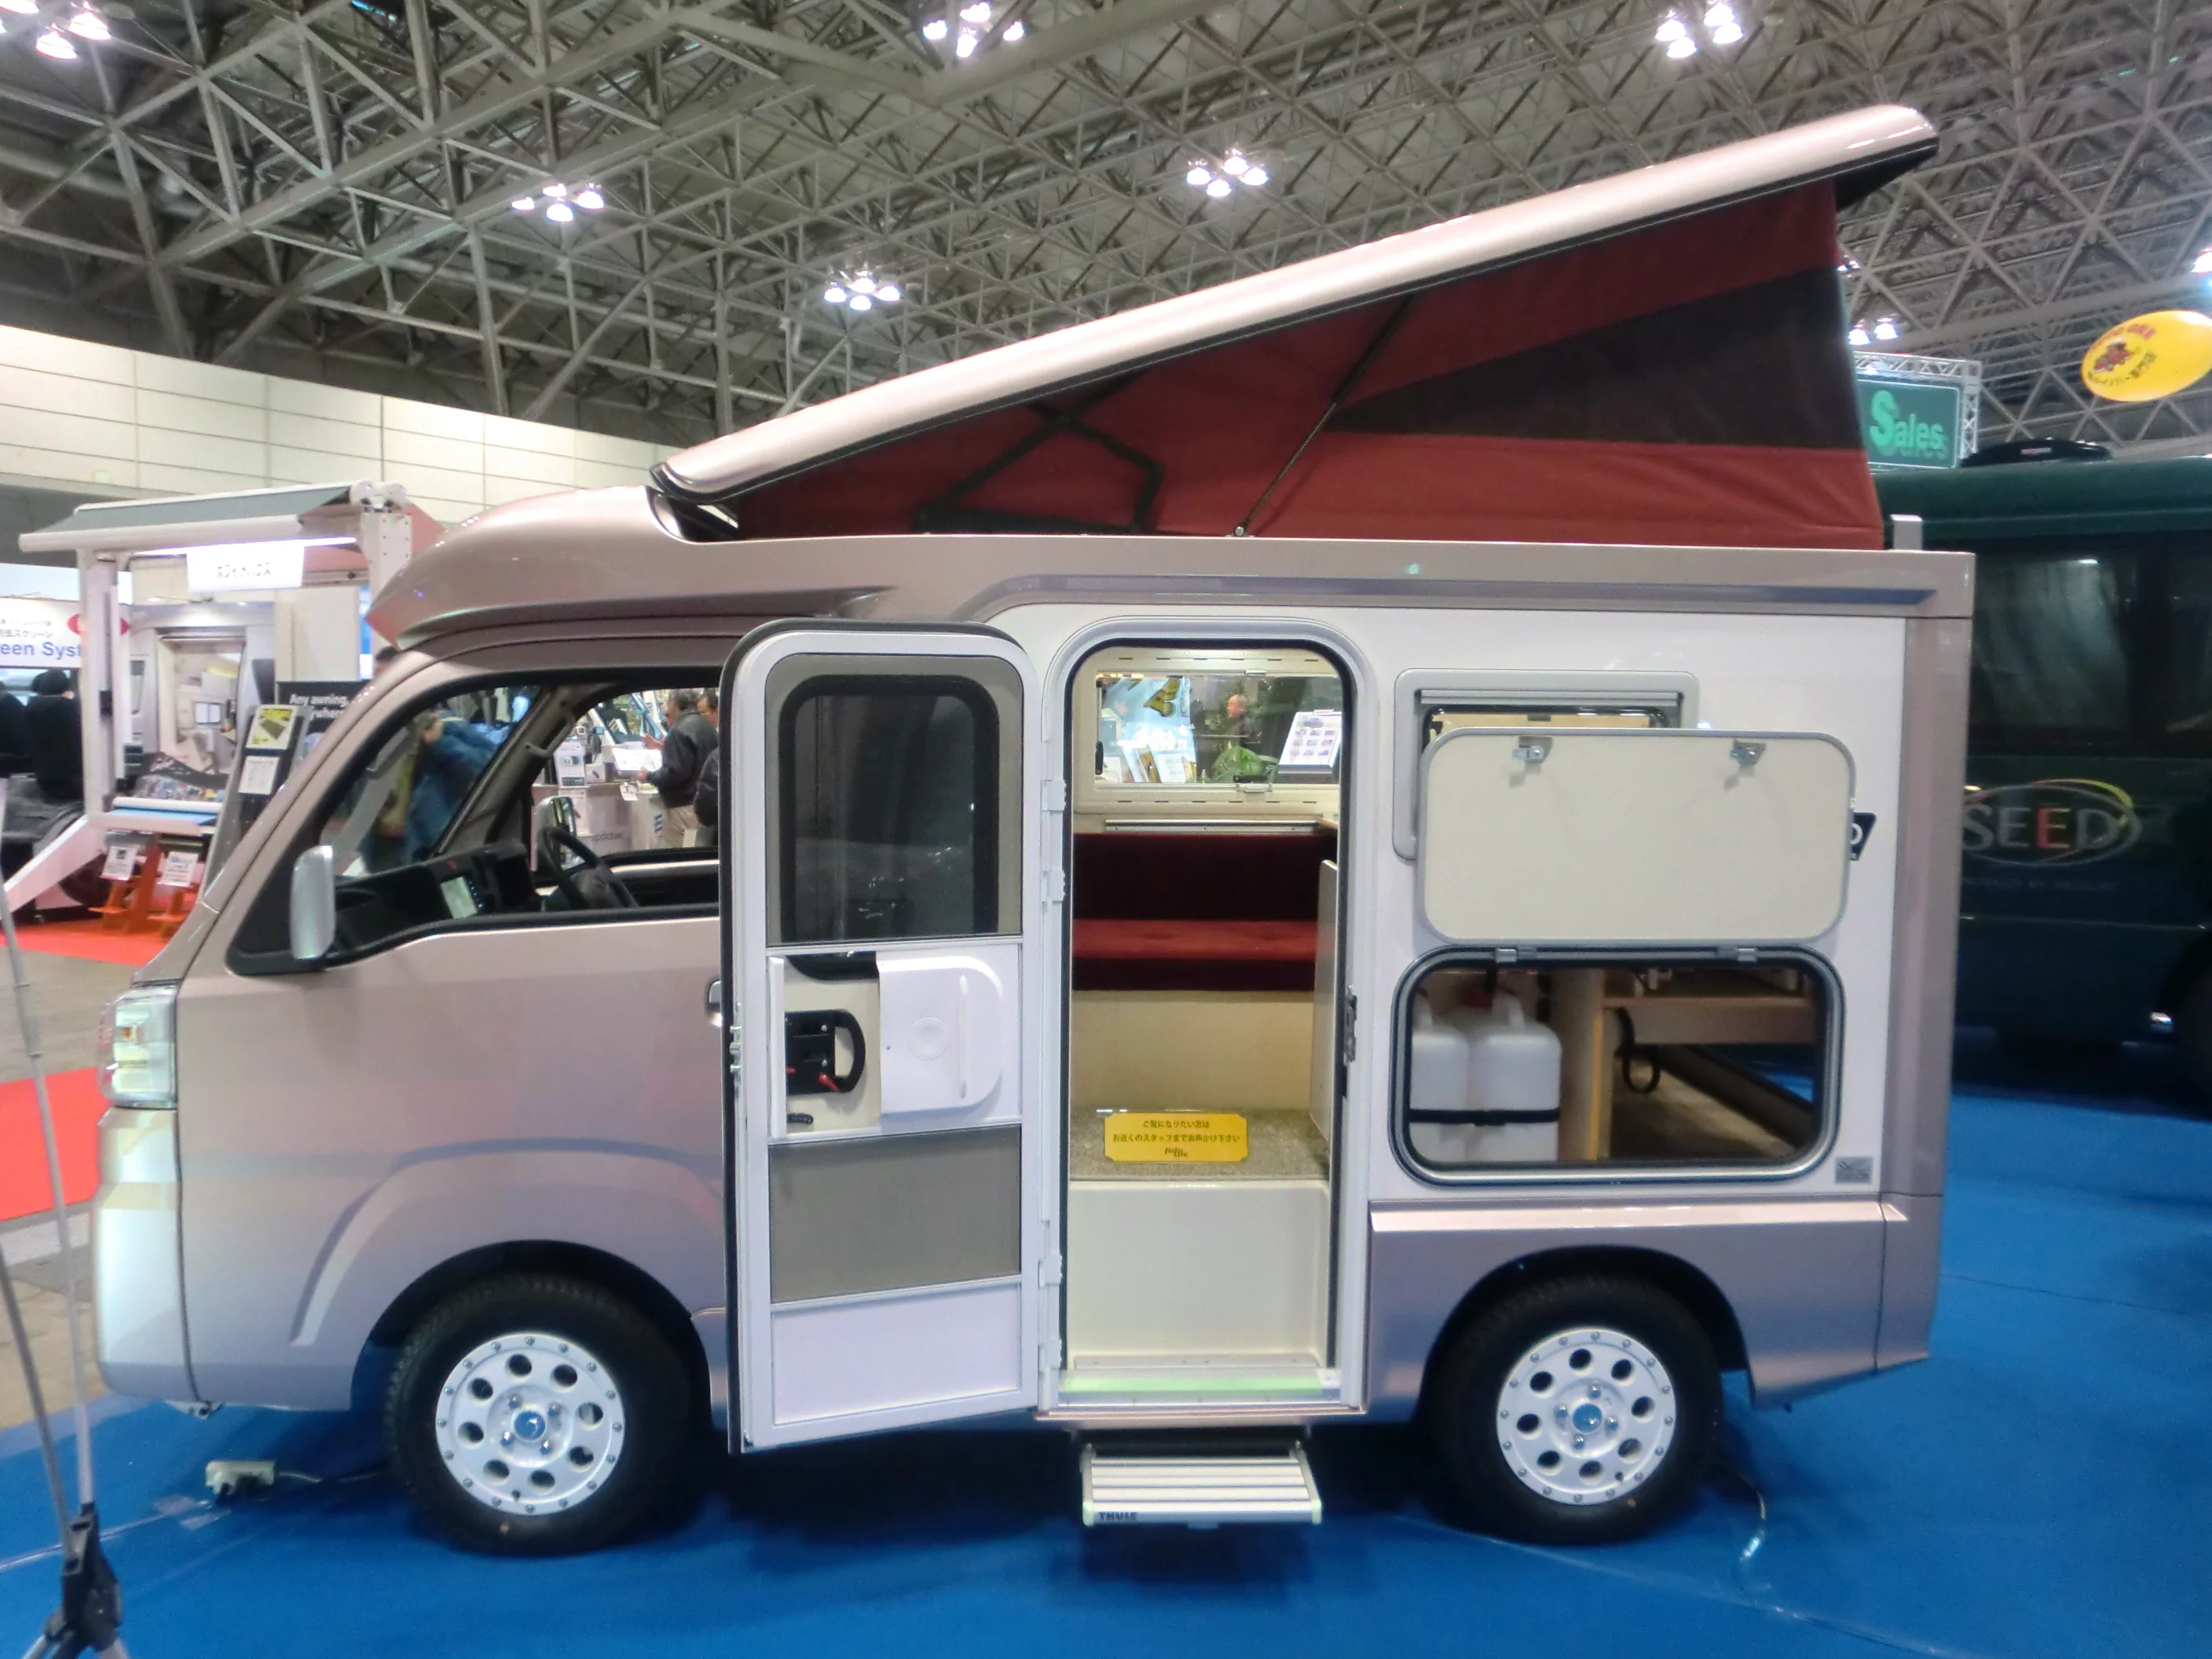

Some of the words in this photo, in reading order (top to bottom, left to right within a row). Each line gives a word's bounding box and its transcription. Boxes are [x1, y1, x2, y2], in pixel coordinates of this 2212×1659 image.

[1870, 390, 1943, 450] Sales
[1962, 802, 2119, 851] SEED
[1098, 1511, 1137, 1521] THULE
